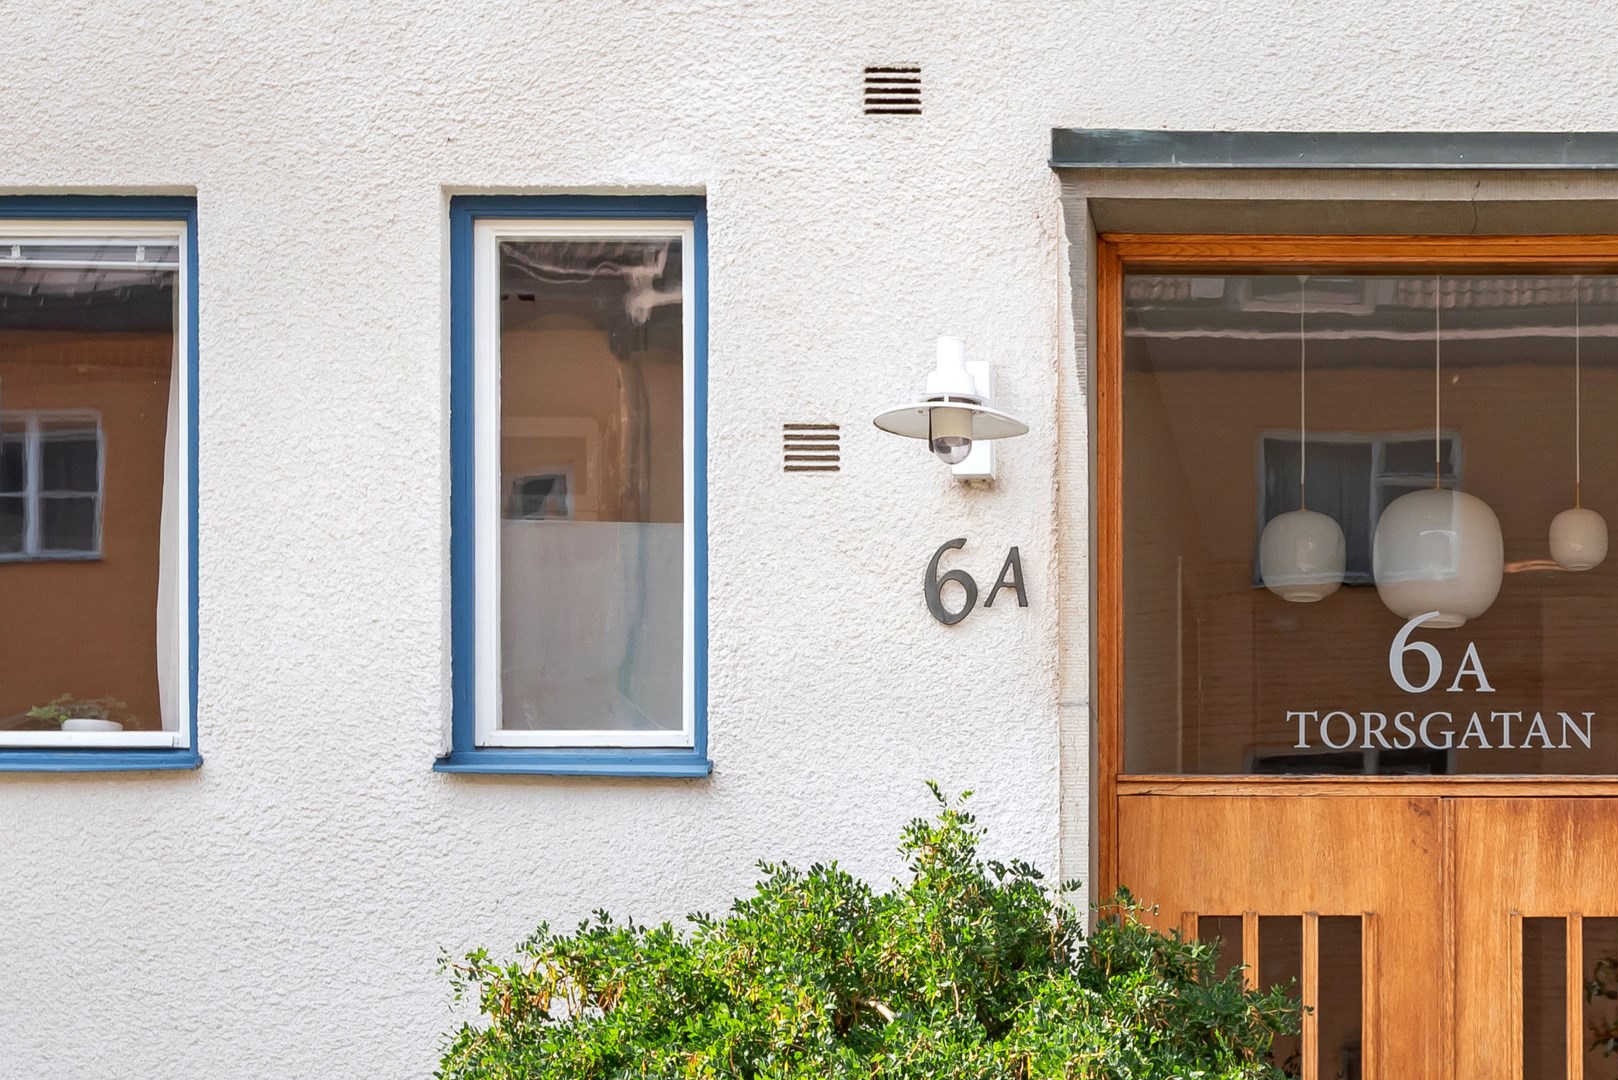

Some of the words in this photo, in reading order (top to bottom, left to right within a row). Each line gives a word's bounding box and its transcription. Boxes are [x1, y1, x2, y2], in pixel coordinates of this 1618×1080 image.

[924, 537, 1029, 626] 6A
[1389, 610, 1496, 694] 6A
[1286, 710, 1596, 750] TORSGATAN
